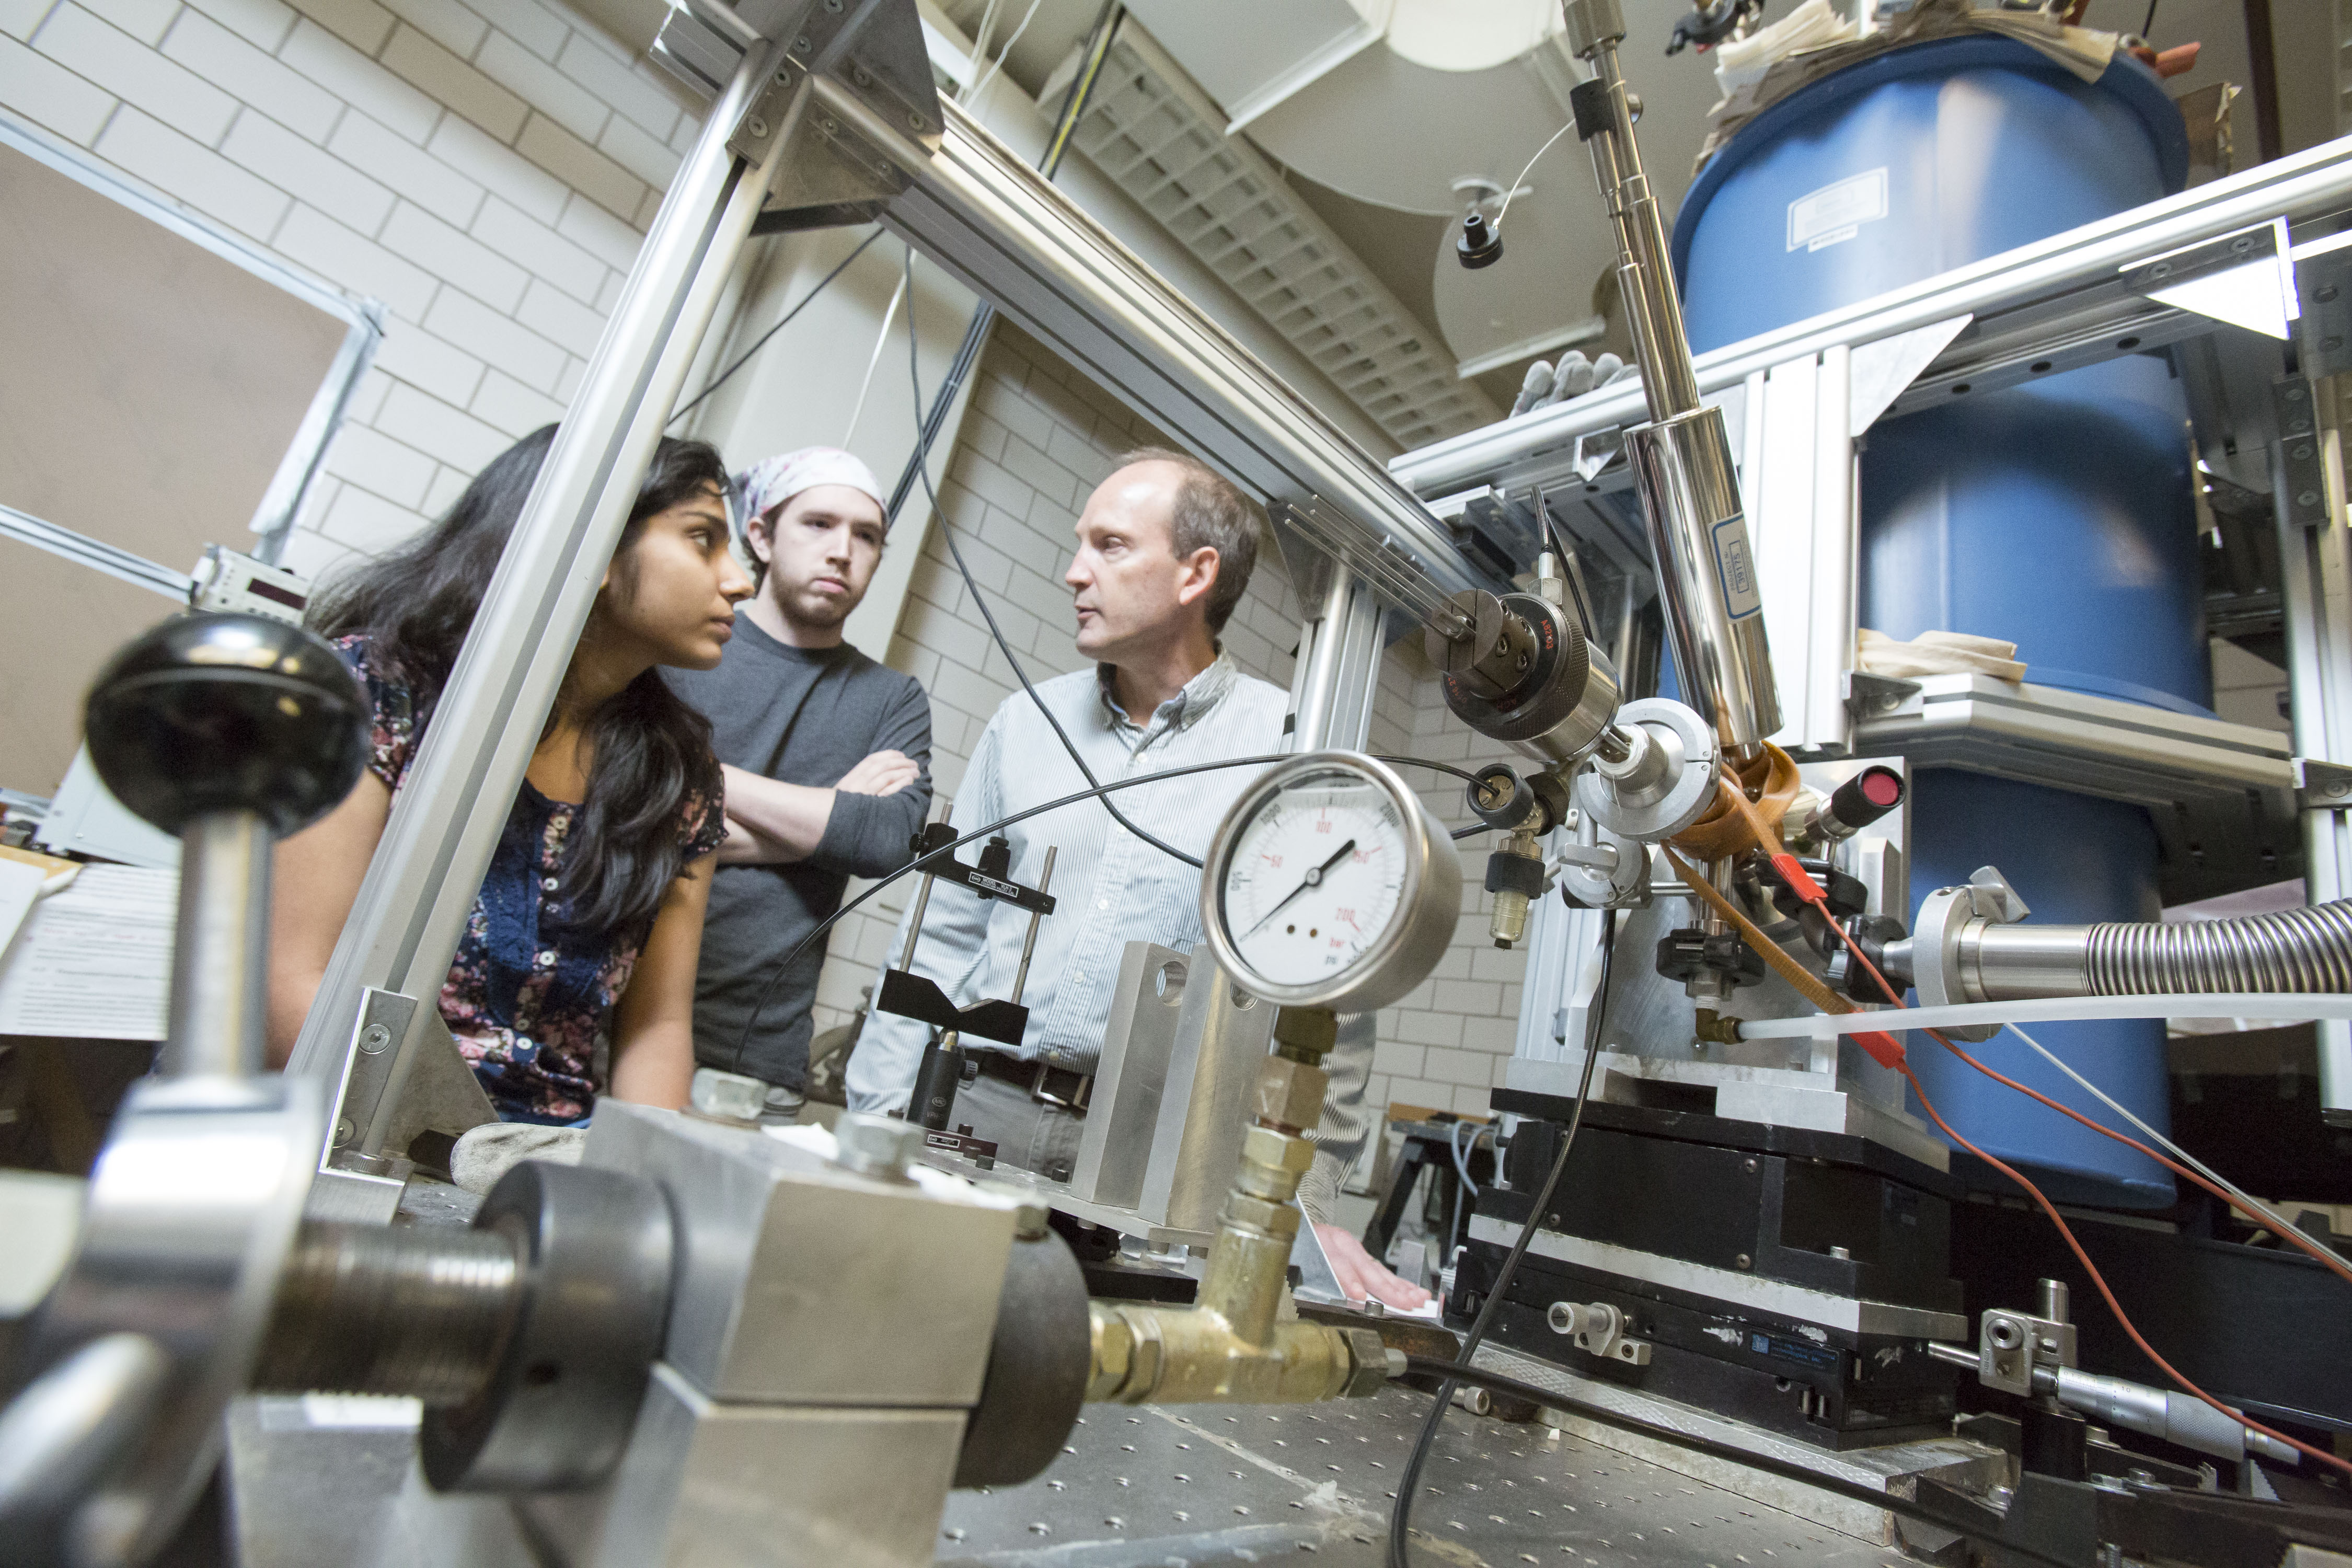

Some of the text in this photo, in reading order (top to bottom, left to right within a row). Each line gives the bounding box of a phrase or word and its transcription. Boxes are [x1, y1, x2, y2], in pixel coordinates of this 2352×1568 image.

[1734, 552, 1745, 584] 39175
[1726, 561, 1735, 591] PROJECT
[1380, 801, 1400, 827] 2000
[1316, 821, 1332, 833] 100
[1271, 855, 1283, 868] 50
[1353, 849, 1370, 864] 150
[981, 881, 996, 889] FOUNTAIN
[983, 878, 996, 886] MODEL
[1335, 907, 1356, 923] 200
[1330, 937, 1346, 949] bar
[1324, 954, 1338, 965] psi
